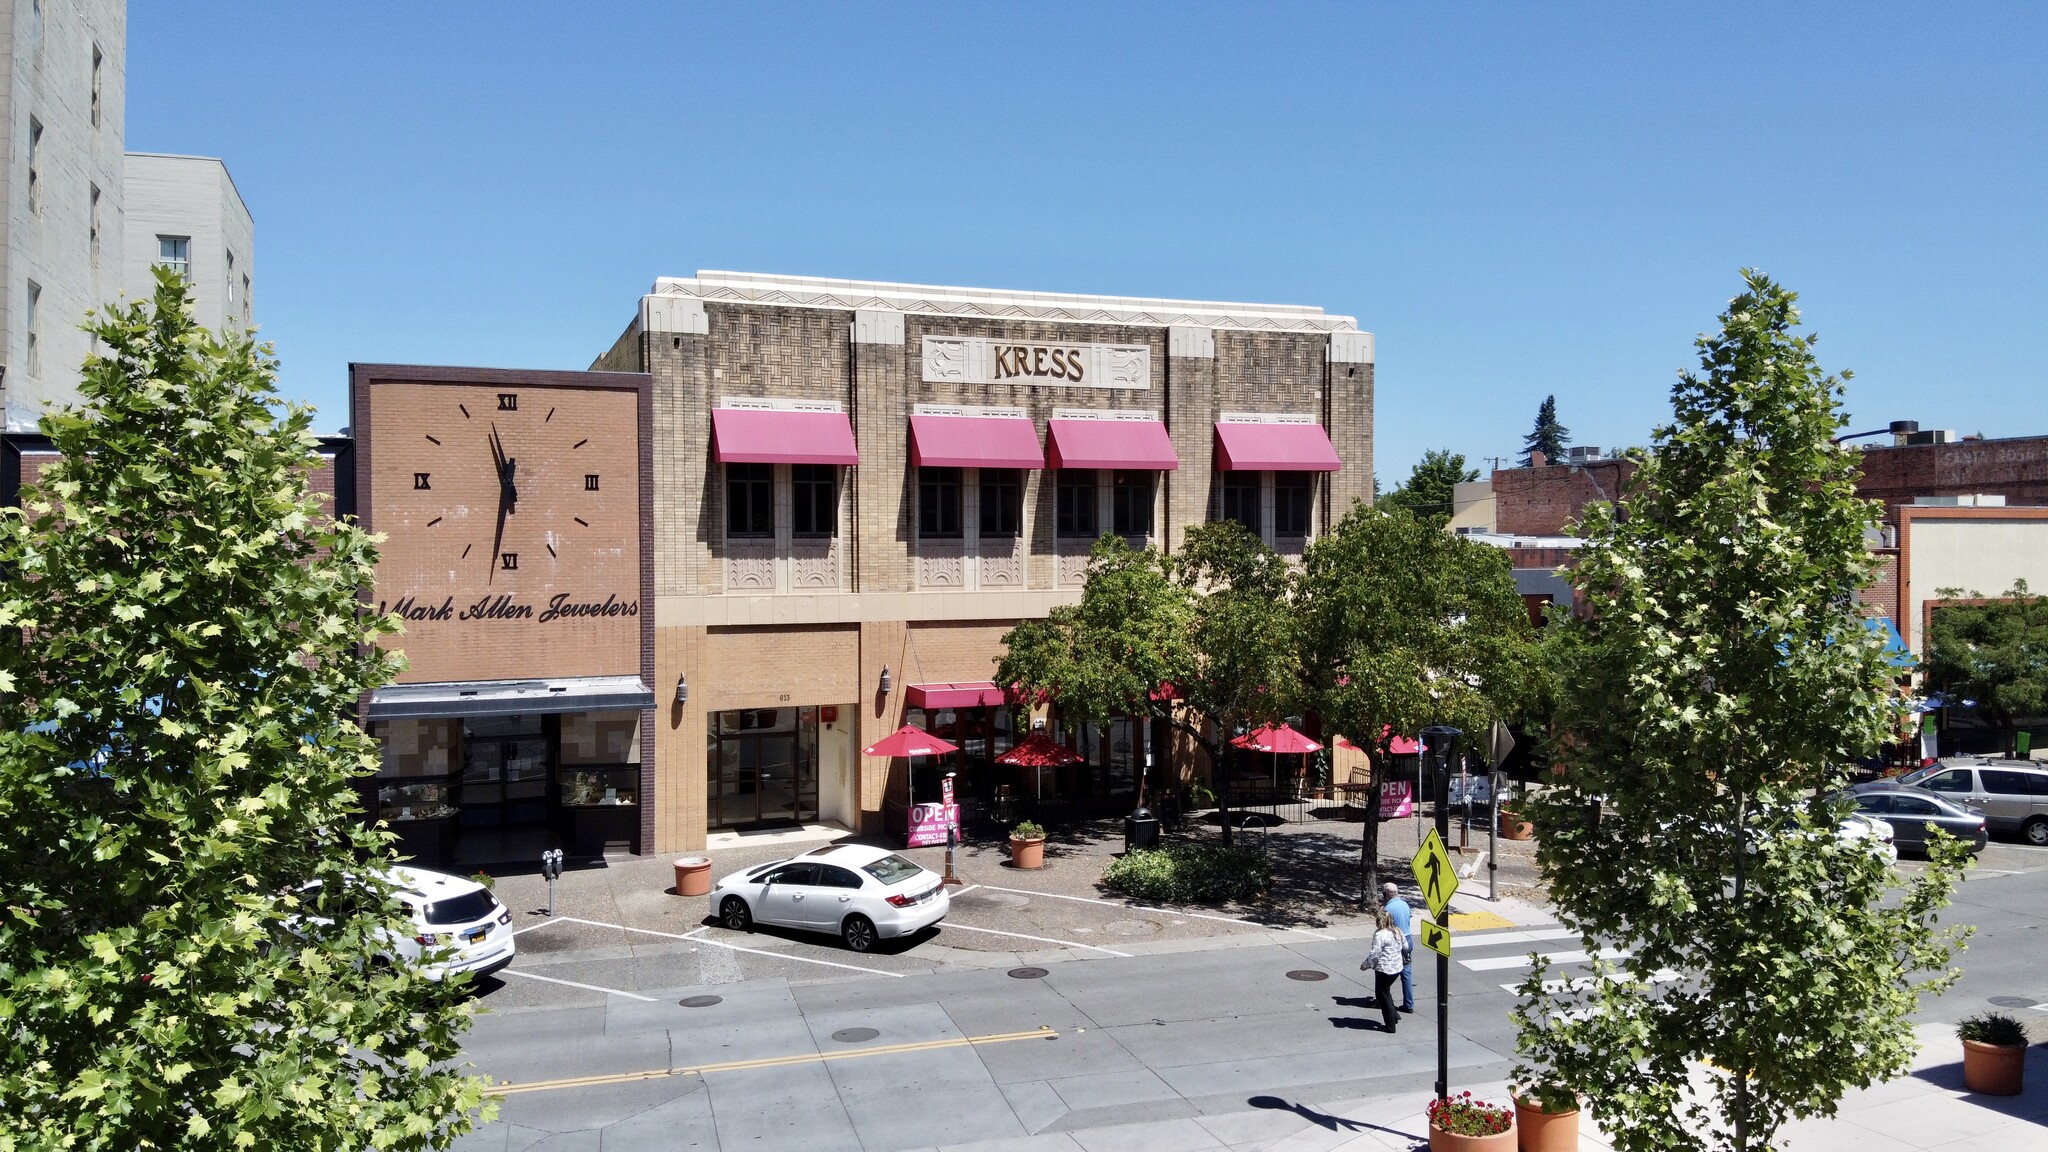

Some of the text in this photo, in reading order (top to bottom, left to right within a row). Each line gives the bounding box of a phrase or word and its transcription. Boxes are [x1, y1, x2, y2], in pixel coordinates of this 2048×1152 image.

[994, 346, 1084, 382] KRESS
[497, 394, 517, 411] XII
[414, 473, 431, 490] IX
[585, 475, 599, 491] III
[501, 553, 518, 569] VI
[377, 593, 638, 623] Mark Allen Jewelers
[1381, 781, 1406, 796] PEN
[913, 806, 954, 823] OPEN
